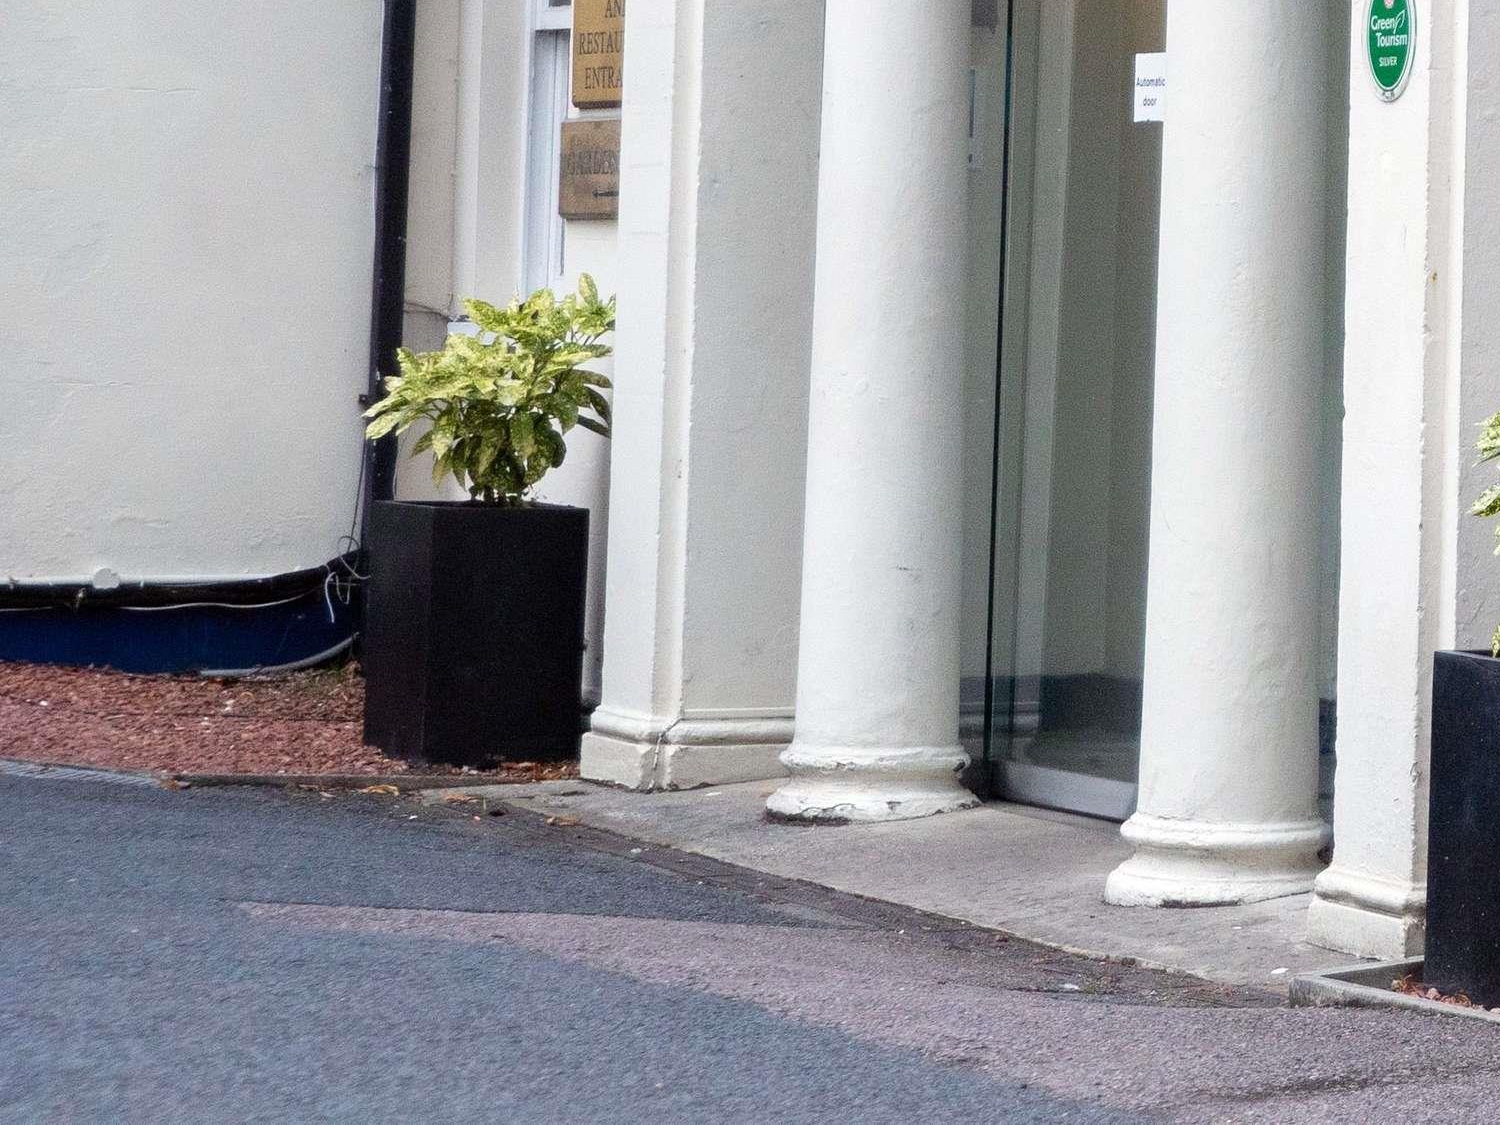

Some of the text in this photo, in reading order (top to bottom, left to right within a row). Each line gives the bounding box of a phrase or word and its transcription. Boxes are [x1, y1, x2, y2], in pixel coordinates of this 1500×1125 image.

[1371, 15, 1396, 31] Green
[1376, 32, 1408, 48] Tourism
[1379, 56, 1398, 67] SILVER
[1136, 77, 1165, 87] Automatic
[1143, 95, 1157, 107] door
